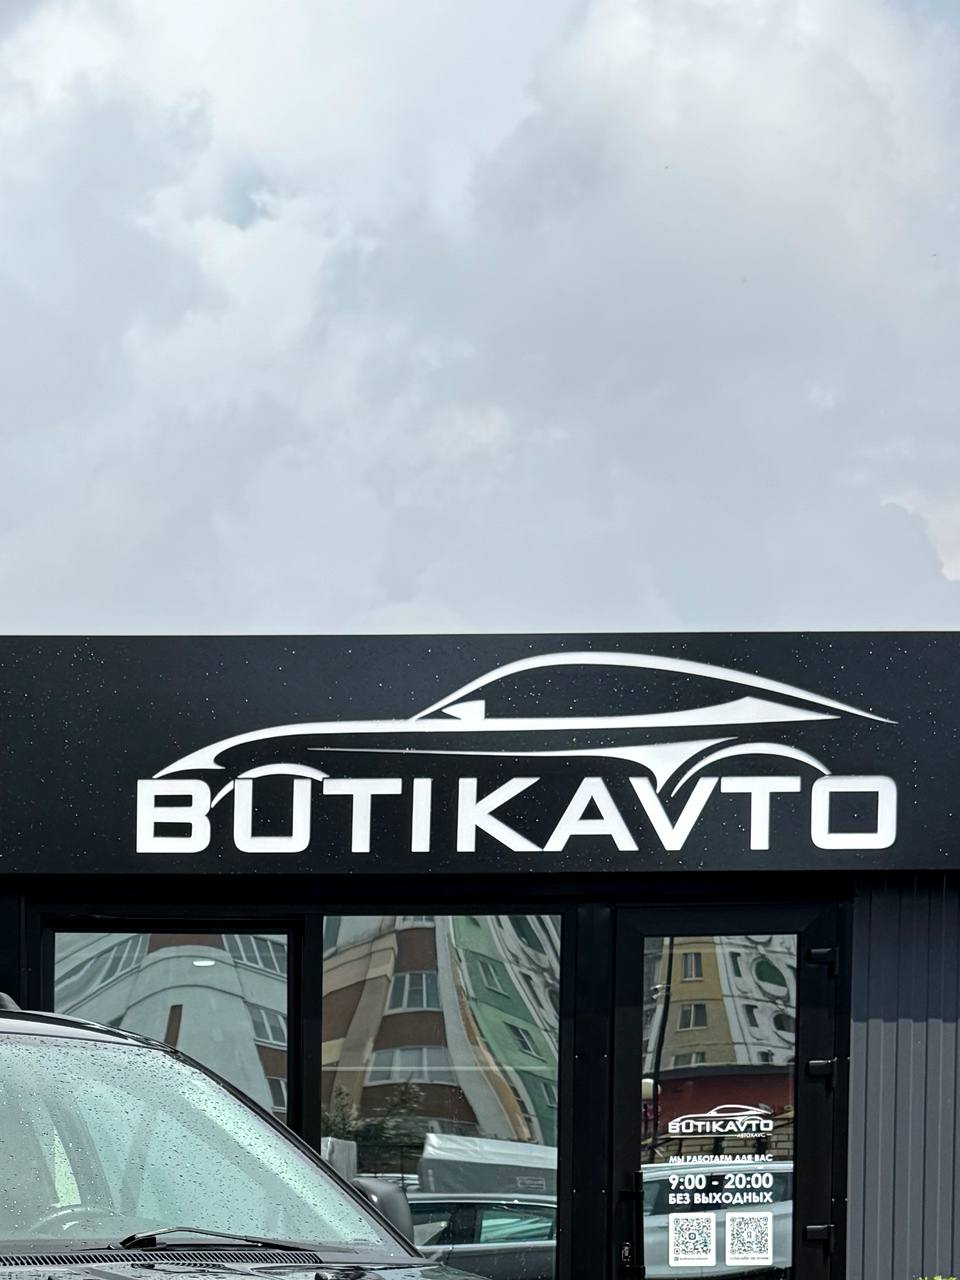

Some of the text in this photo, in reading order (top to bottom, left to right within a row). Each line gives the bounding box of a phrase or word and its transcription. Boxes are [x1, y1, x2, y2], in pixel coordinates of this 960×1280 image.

[135, 774, 899, 854] BUTIKAVTO
[667, 1119, 774, 1134] BUTIKAVTO
[668, 1155, 685, 1164] МЫ
[686, 1154, 734, 1163] РАБОТАЕМ
[754, 1153, 774, 1162] ВАС
[668, 1174, 707, 1190] 9:00
[724, 1173, 774, 1189] 20:00
[668, 1191, 774, 1205] БЕЗ ВЫХОДНЫХ
